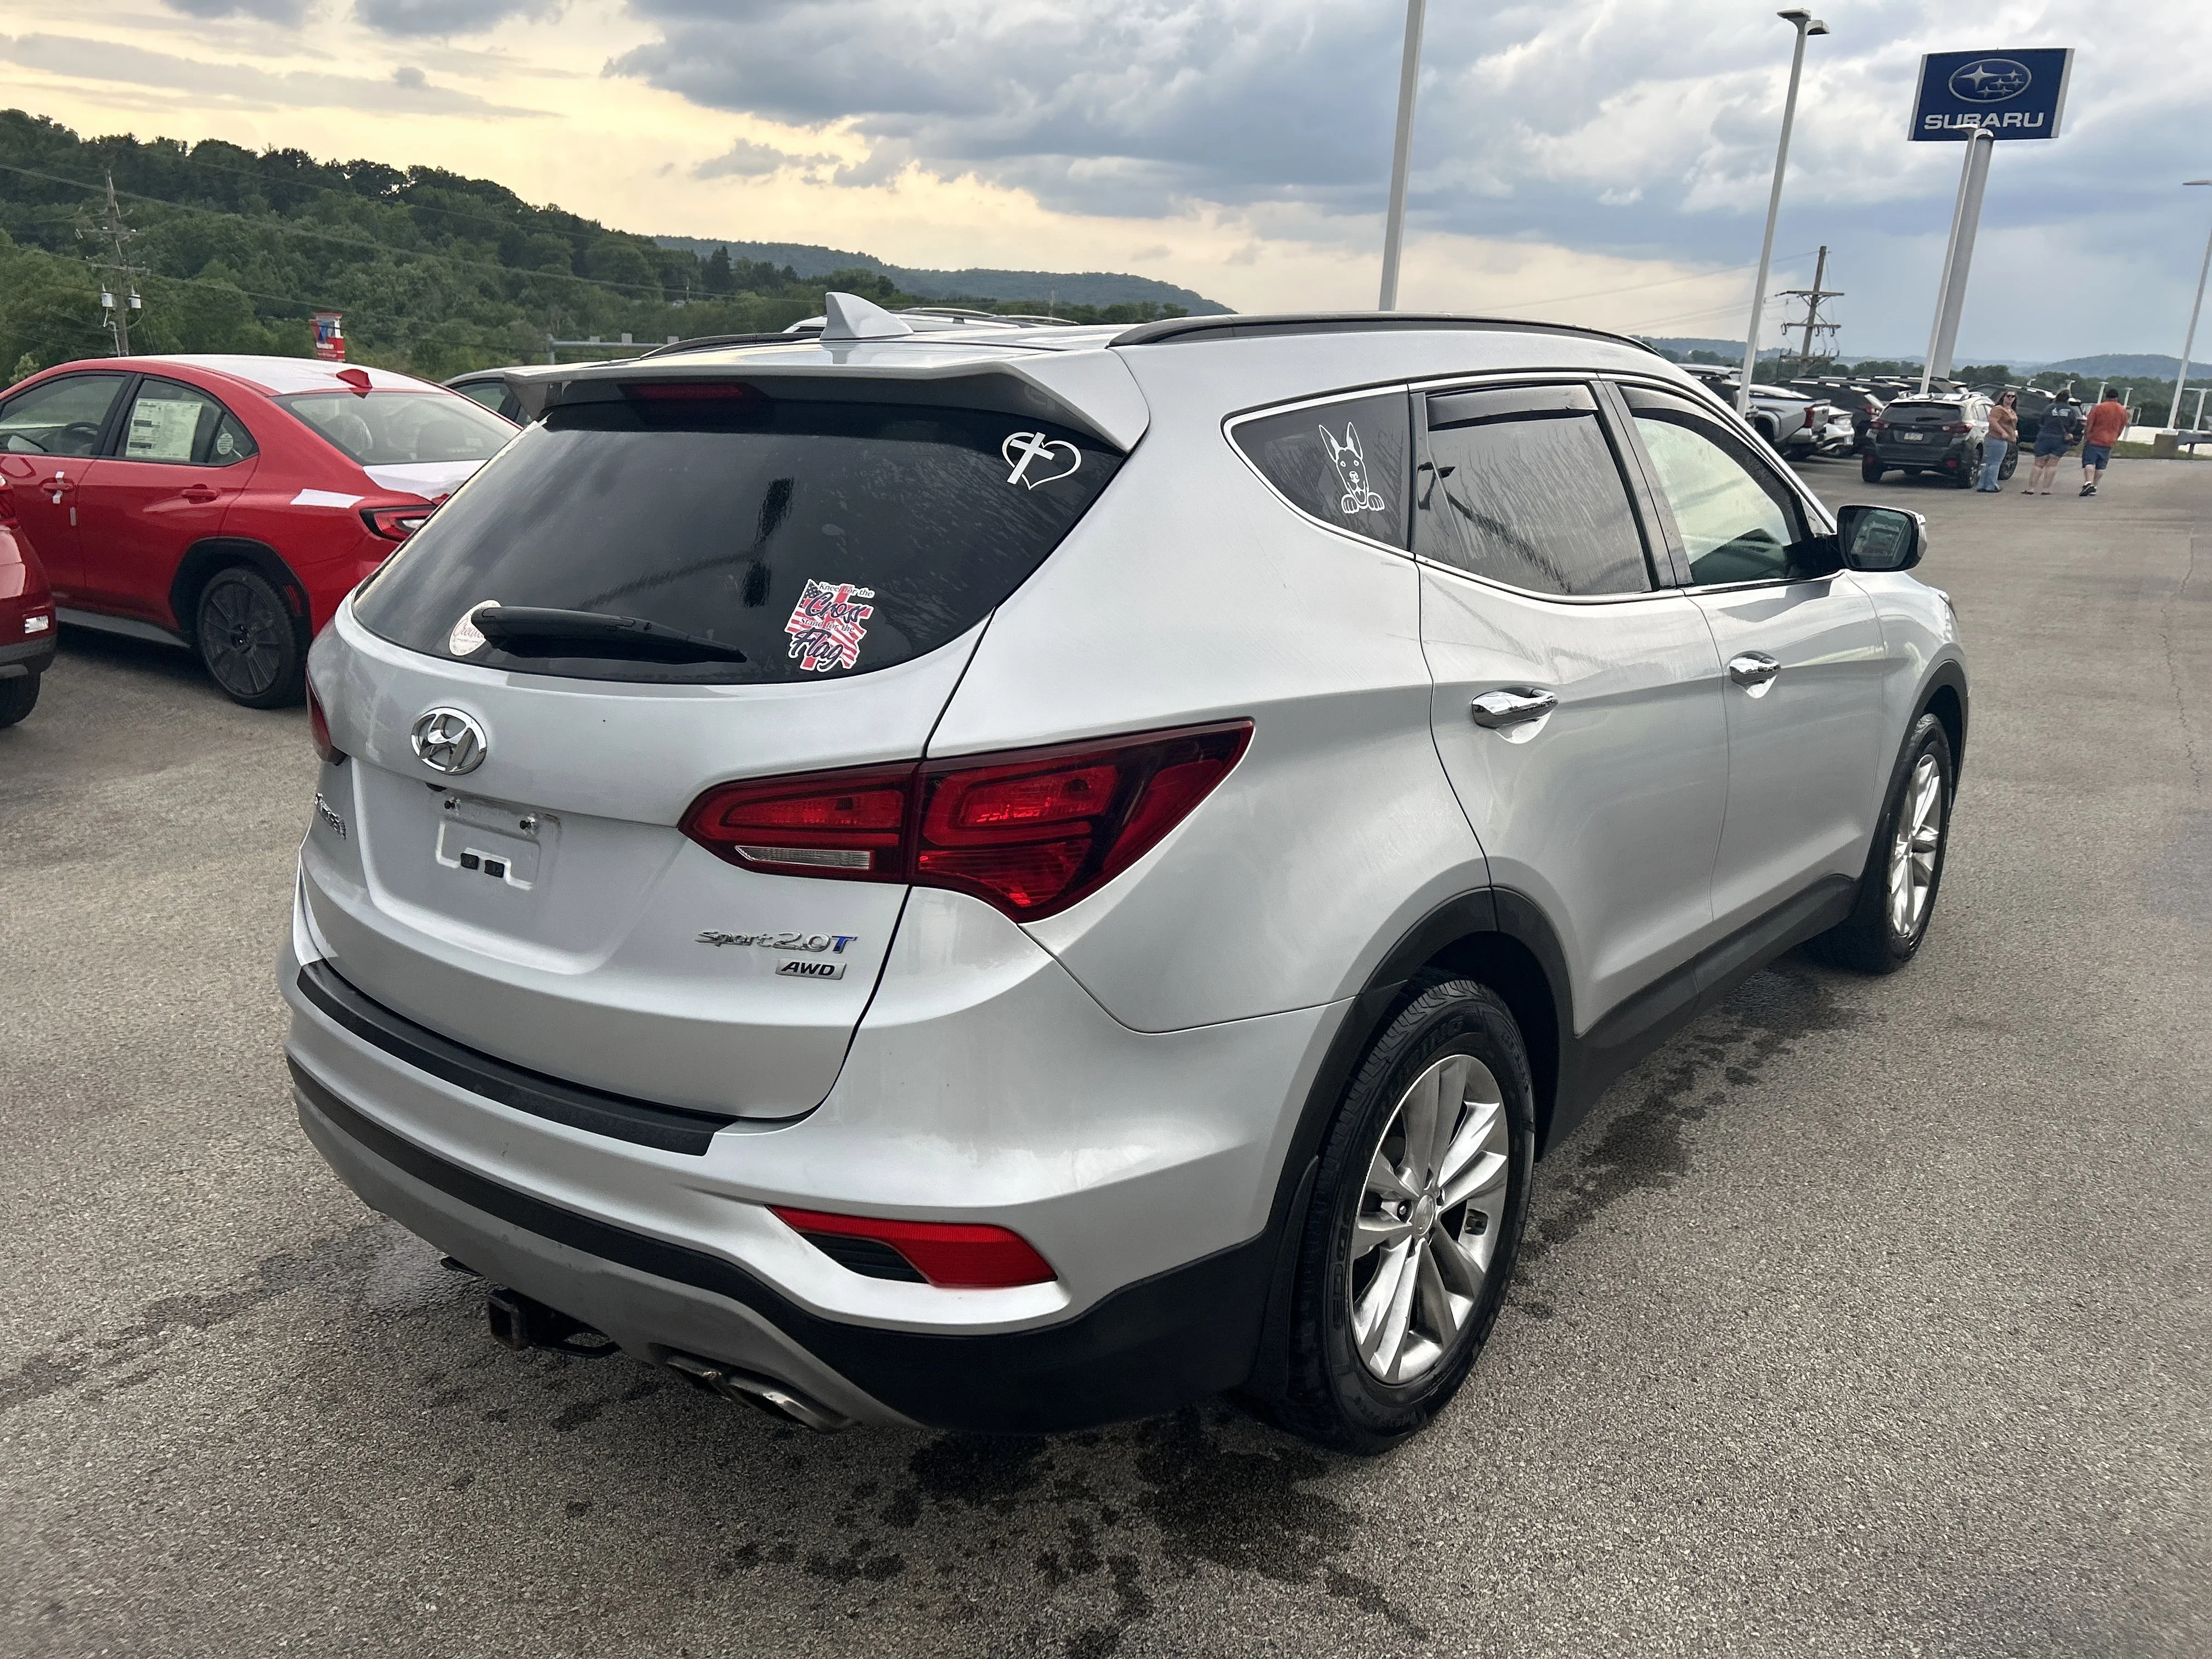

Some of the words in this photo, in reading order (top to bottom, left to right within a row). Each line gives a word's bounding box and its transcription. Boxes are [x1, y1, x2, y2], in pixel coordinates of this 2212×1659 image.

[1924, 112, 2045, 130] SUBARU
[819, 583, 842, 592] Kneel
[844, 586, 857, 595] for
[859, 589, 873, 597] the
[805, 592, 867, 624] Cross
[800, 618, 824, 627] Stand
[826, 622, 840, 631] for
[841, 624, 855, 633] the
[791, 628, 844, 669] Flag
[781, 961, 836, 977] AWD
